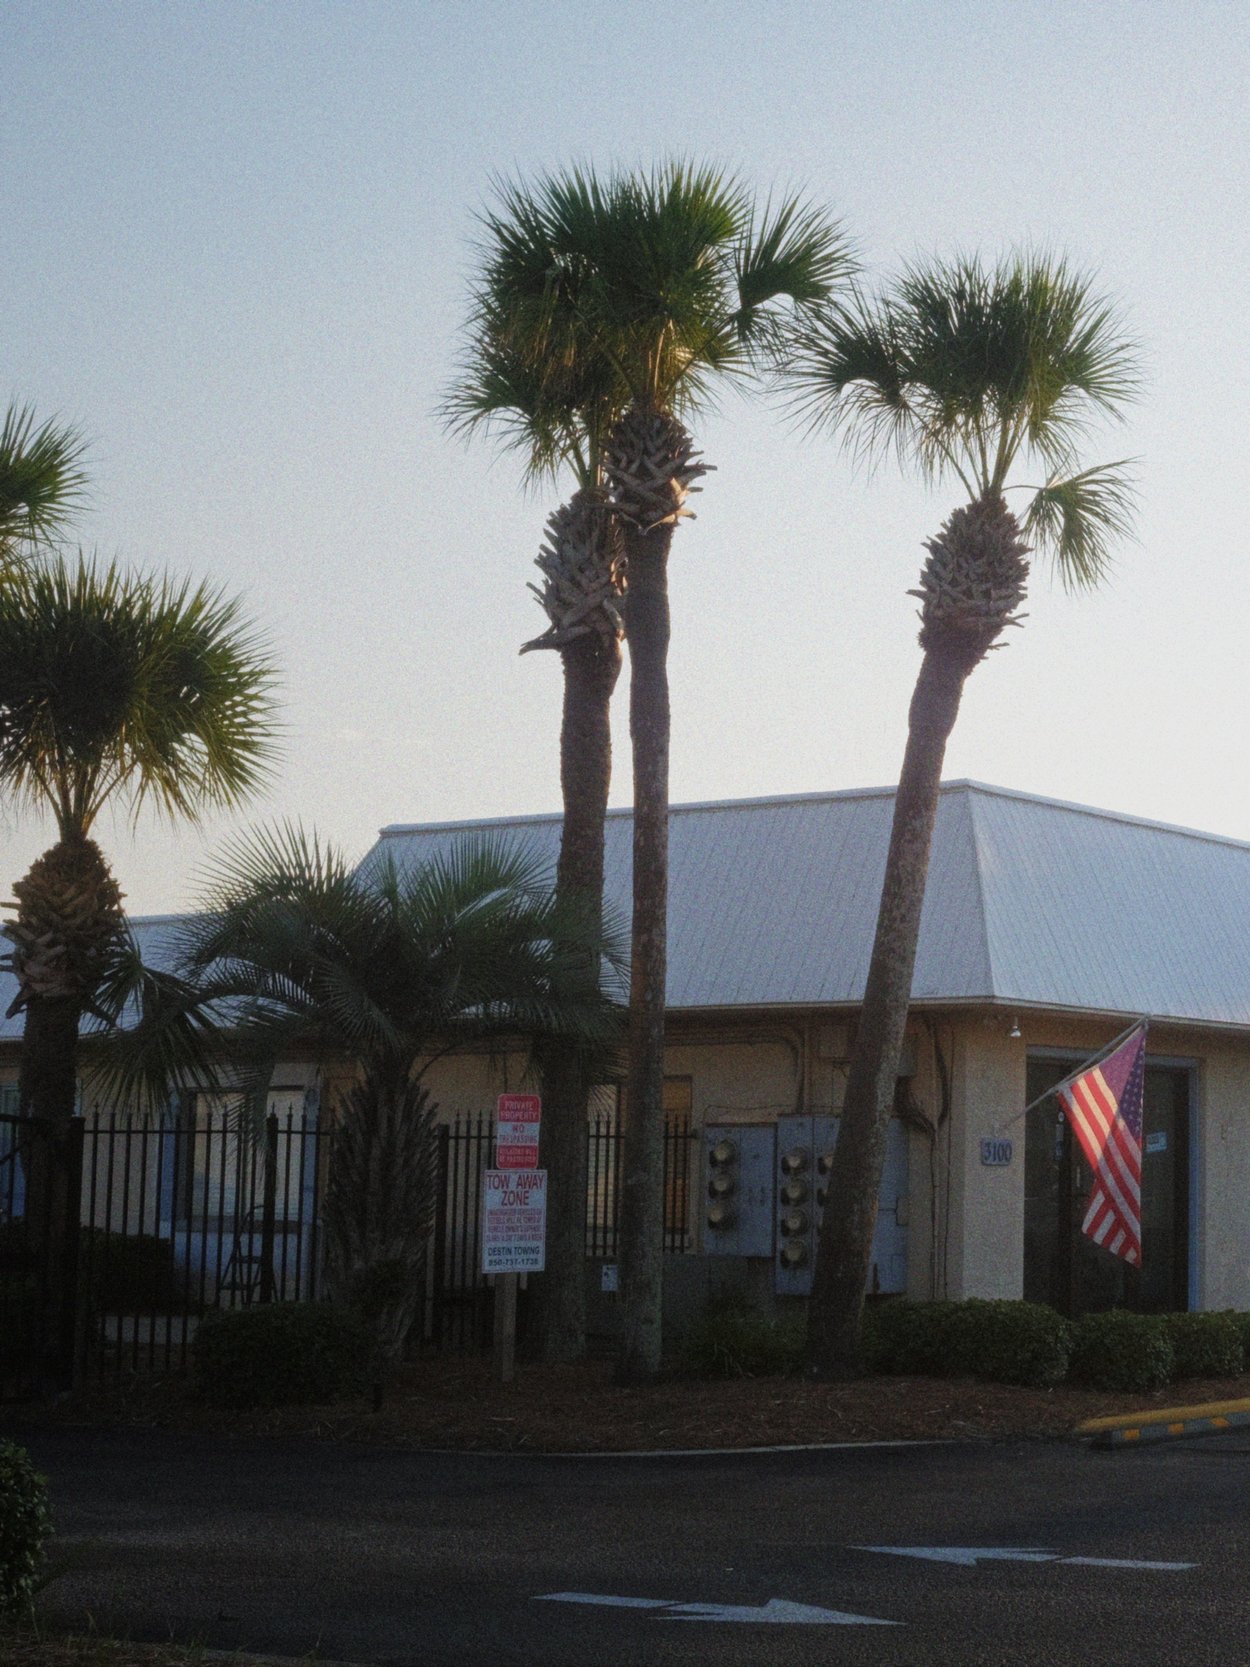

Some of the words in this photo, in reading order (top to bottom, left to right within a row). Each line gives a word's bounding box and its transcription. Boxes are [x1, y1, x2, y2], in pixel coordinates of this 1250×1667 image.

[504, 1100, 534, 1111] PRIVATE
[500, 1110, 537, 1120] PROPERTY
[512, 1123, 525, 1133] NO
[983, 1142, 1012, 1162] 3100
[487, 1174, 510, 1190] TOW
[516, 1174, 544, 1190] AWAY
[501, 1190, 530, 1206] ZONE
[487, 1246, 512, 1256] DESTIN
[514, 1246, 540, 1255] TOWING
